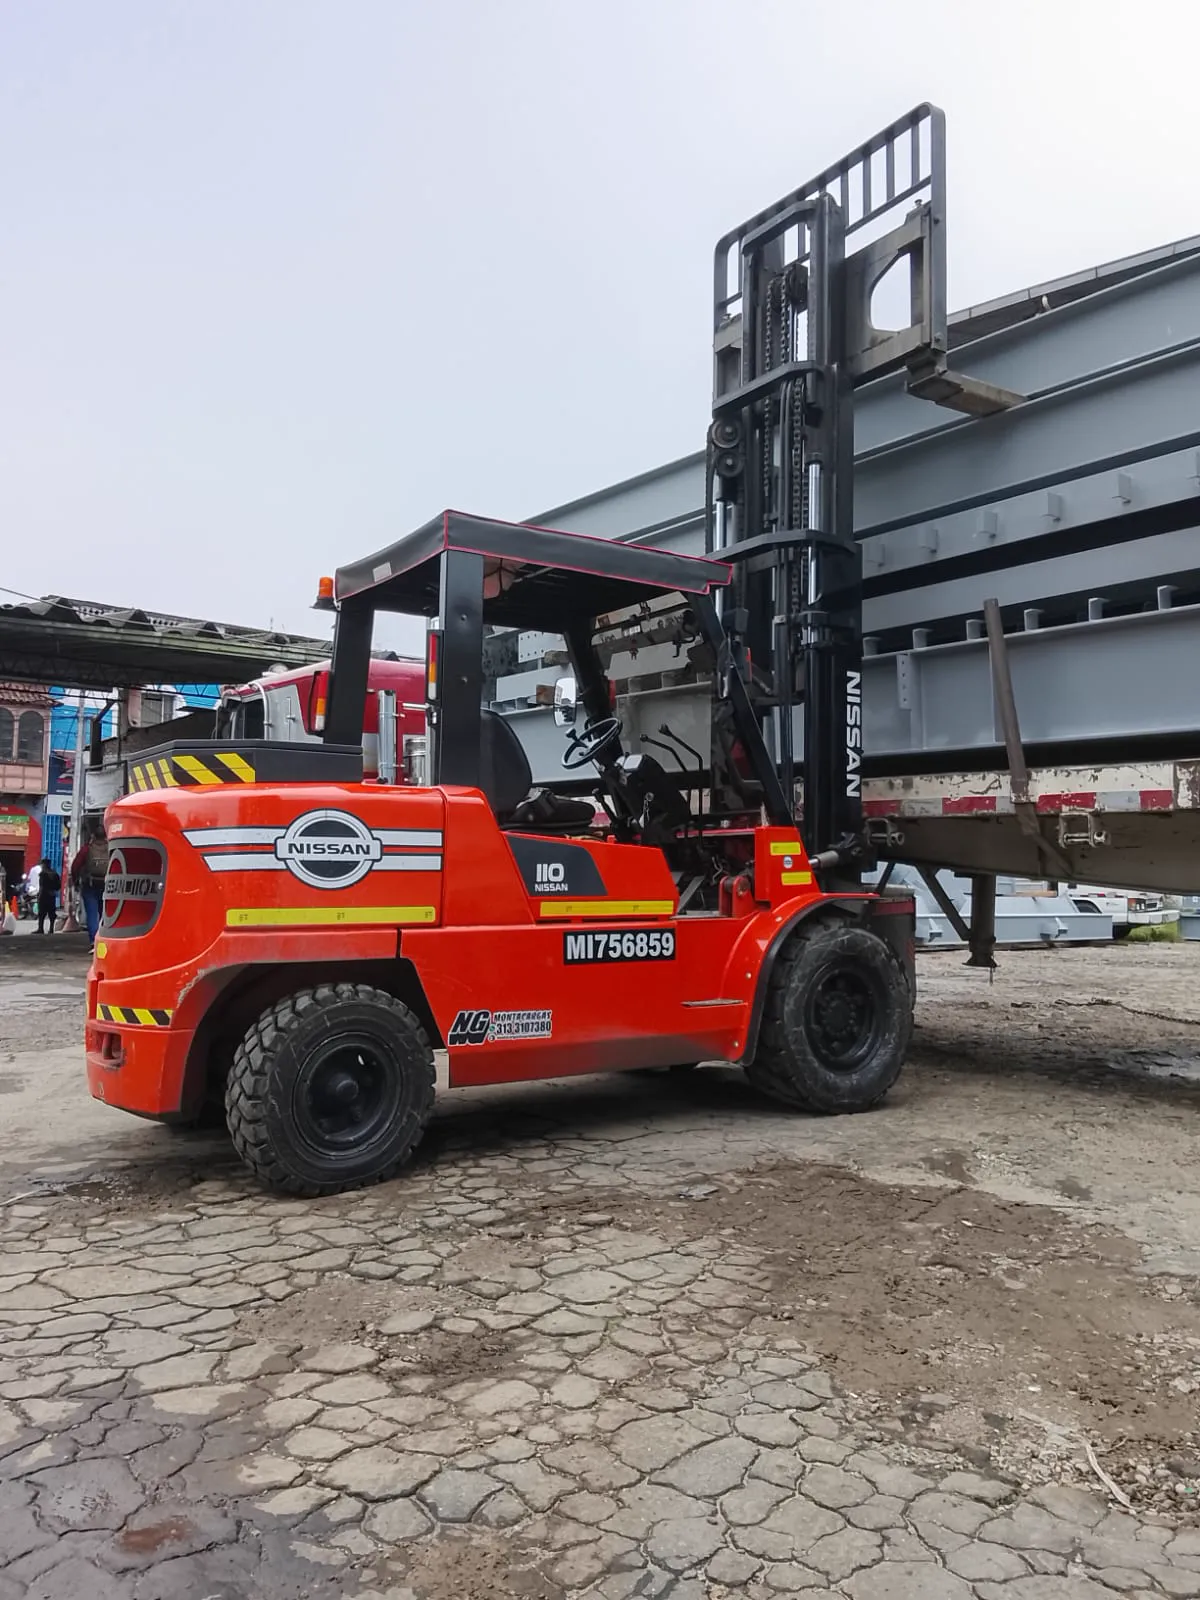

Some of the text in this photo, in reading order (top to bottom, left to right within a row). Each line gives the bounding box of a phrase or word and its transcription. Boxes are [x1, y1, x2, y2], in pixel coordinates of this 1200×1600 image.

[847, 671, 861, 797] NISSAN
[288, 843, 370, 855] NISSAN
[536, 863, 564, 882] 110
[535, 883, 568, 891] NISSAN
[566, 932, 674, 960] MI756859
[450, 1010, 490, 1038] NG
[494, 1011, 551, 1021] MONTACARGAS
